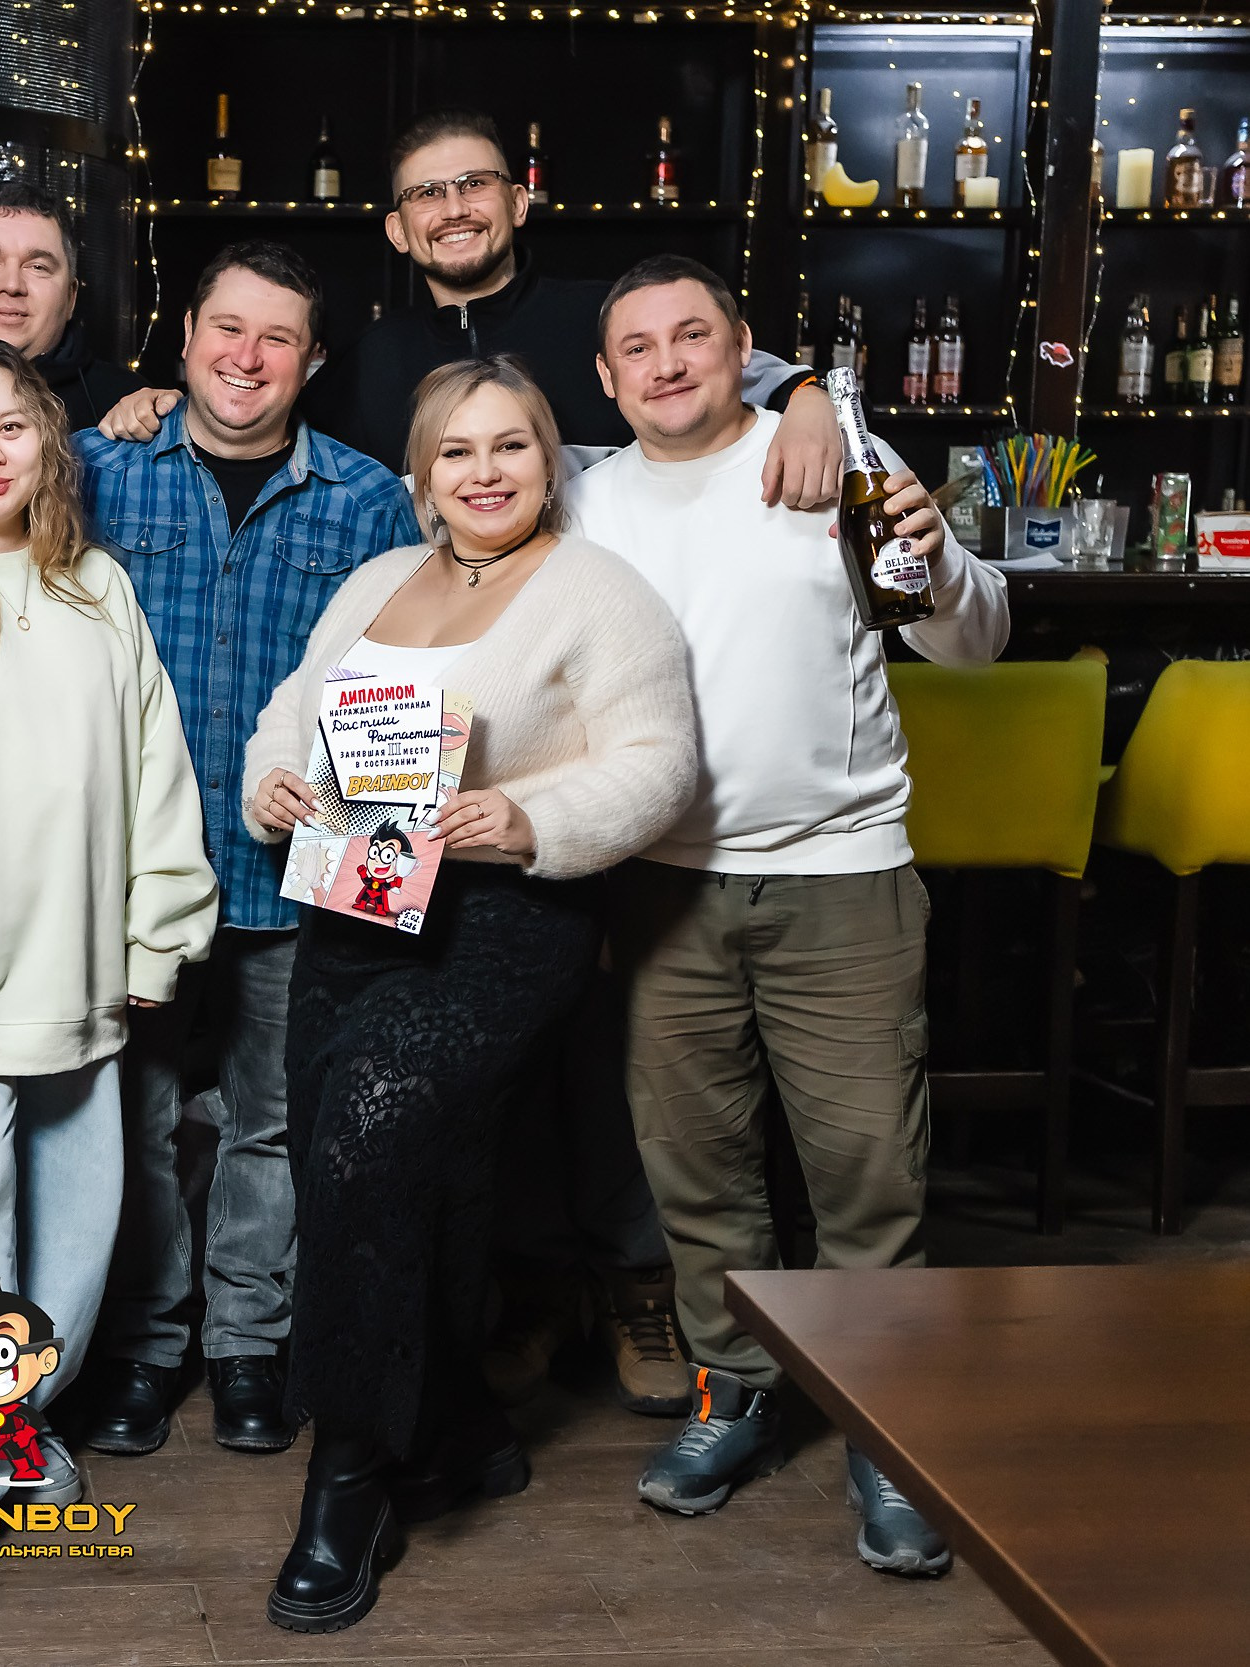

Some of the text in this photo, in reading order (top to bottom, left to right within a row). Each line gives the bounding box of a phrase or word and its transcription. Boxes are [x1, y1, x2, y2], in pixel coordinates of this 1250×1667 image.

[885, 555, 925, 569] BELBO
[339, 684, 415, 707] ДИПЛОМОМ
[329, 700, 431, 717] НАГРАЖДАЕТСЯ КОМАНДА
[340, 749, 386, 759] ЗАНЯВШАЯ
[403, 746, 430, 755] МЕСТО
[364, 757, 417, 768] СОСТЯЗАНИИ
[346, 772, 435, 797] BRAINBOY
